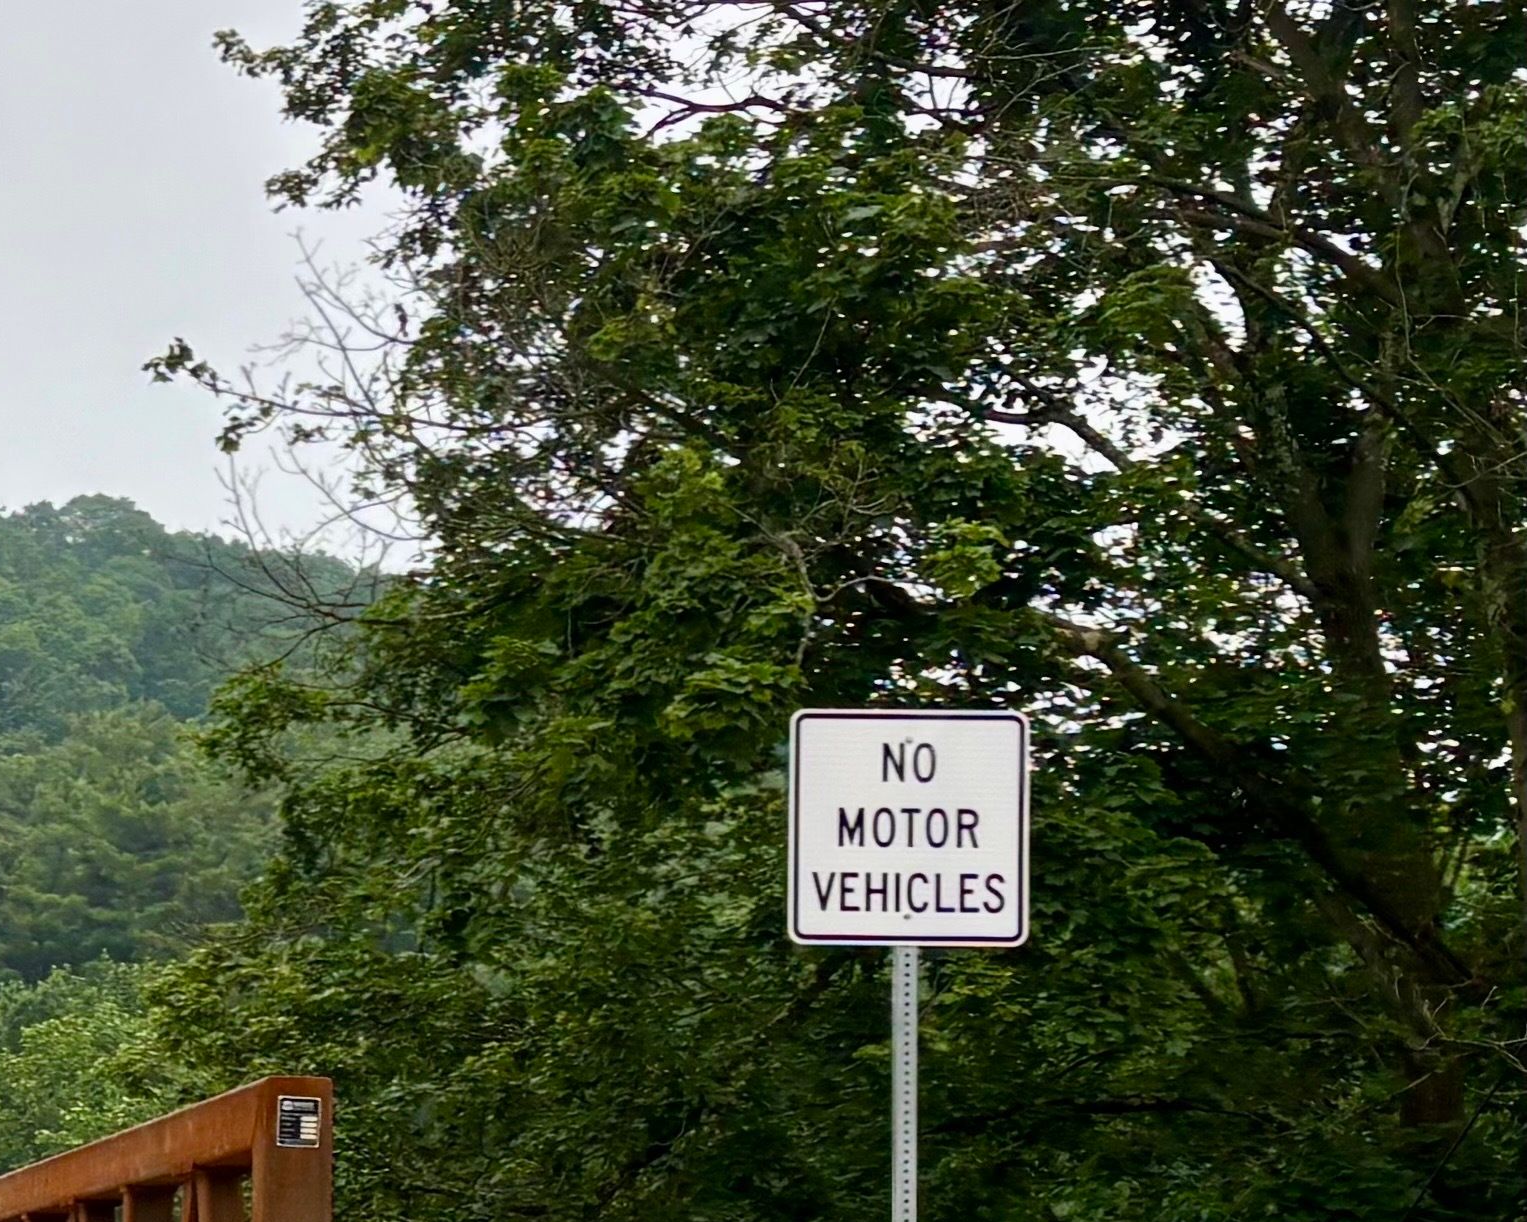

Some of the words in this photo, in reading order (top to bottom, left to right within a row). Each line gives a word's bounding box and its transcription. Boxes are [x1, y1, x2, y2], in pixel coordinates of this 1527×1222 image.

[882, 742, 937, 783] NO
[838, 807, 980, 848] MOTOR
[812, 872, 1006, 914] VEHICLES
